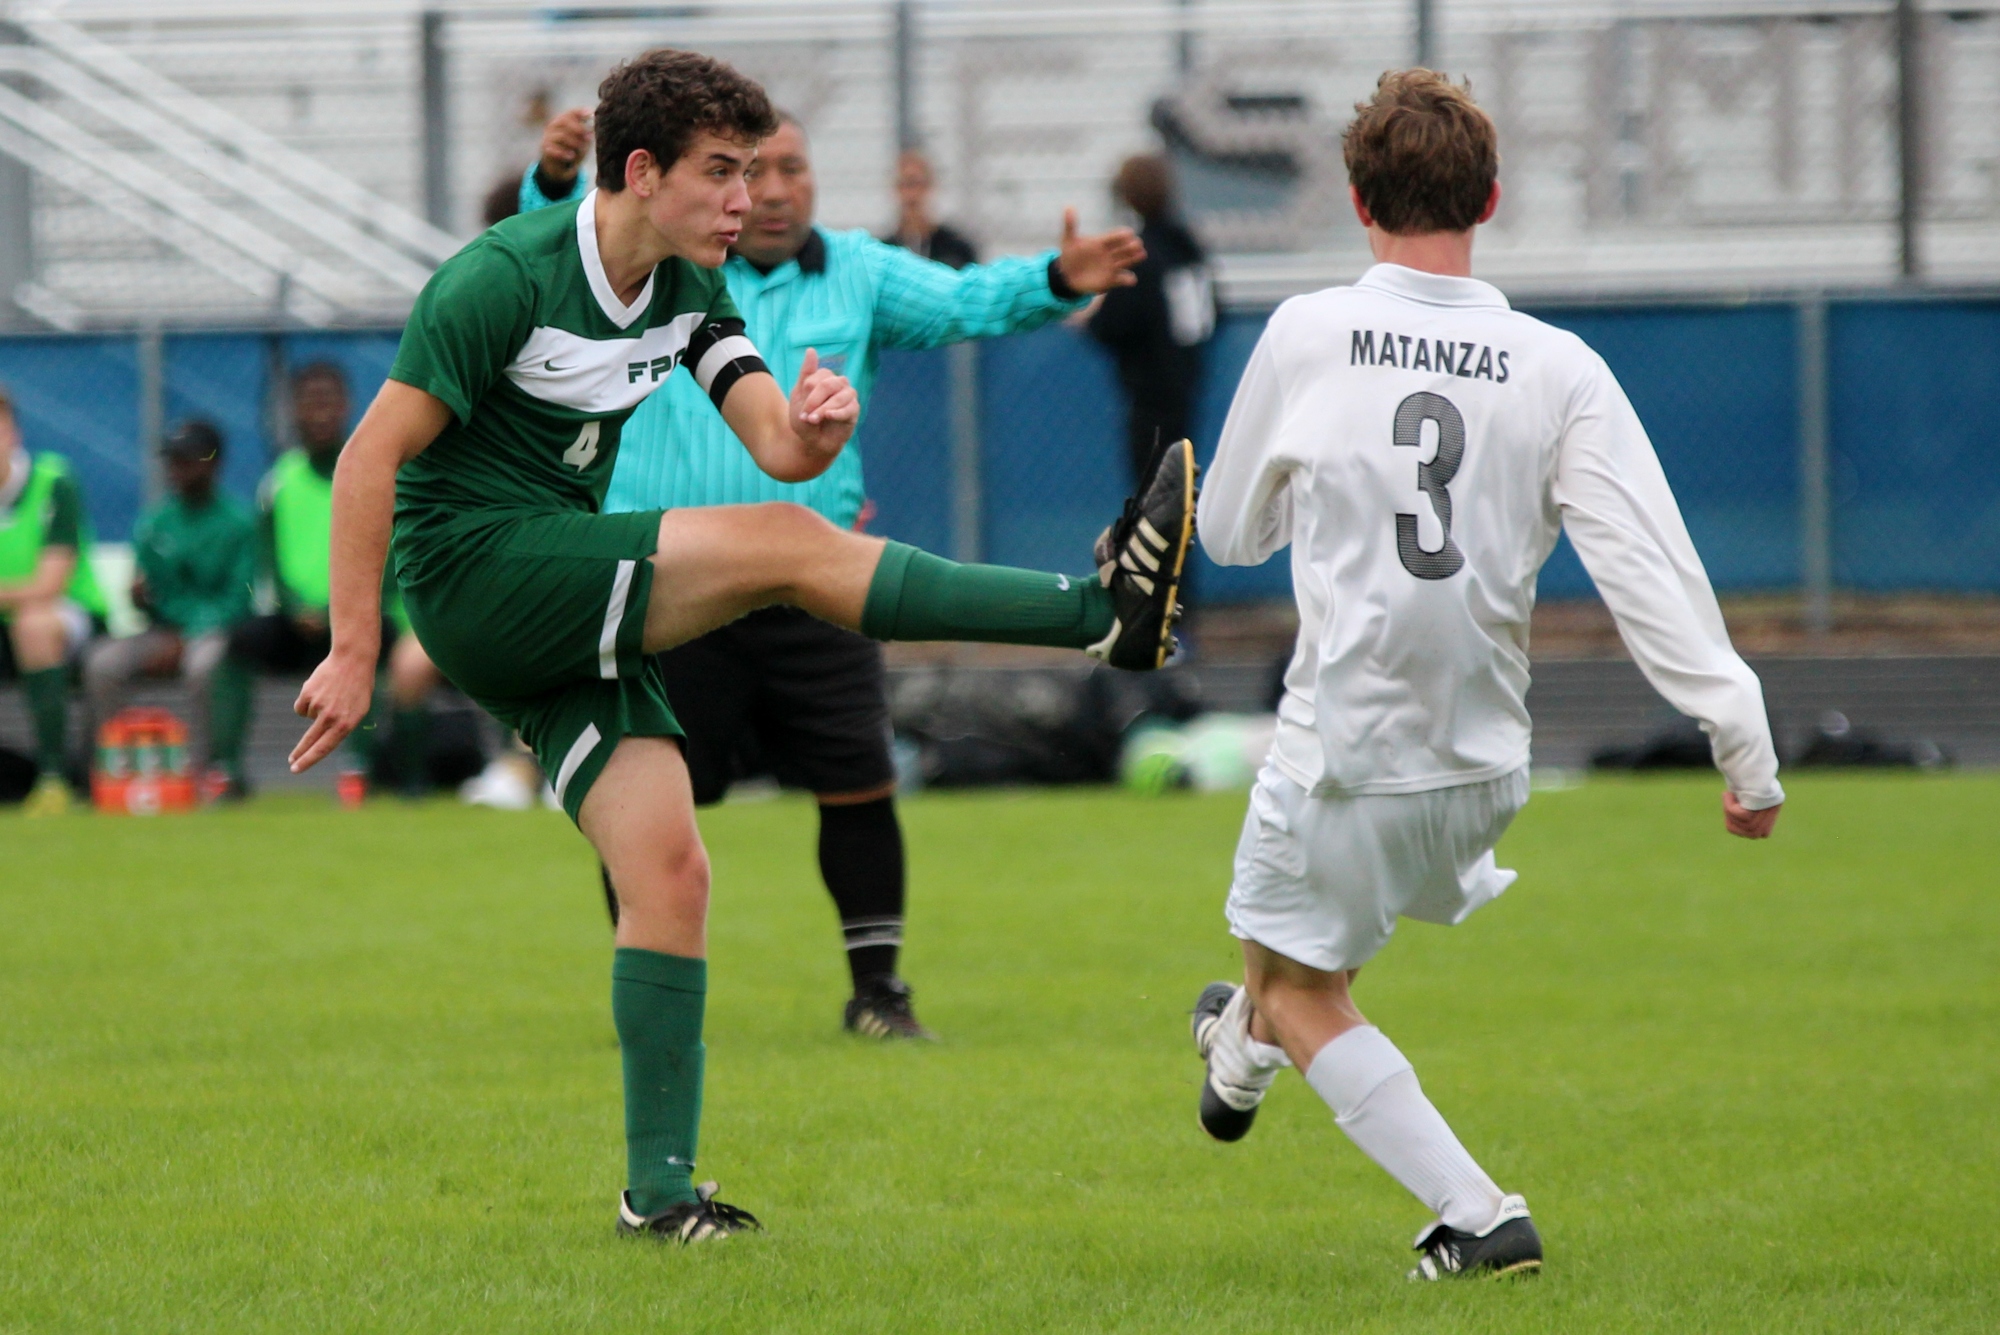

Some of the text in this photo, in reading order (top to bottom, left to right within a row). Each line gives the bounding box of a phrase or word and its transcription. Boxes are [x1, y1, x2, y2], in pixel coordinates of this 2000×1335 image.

[1350, 330, 1510, 384] MATANZAS
[562, 421, 600, 473] 4
[1393, 391, 1466, 580] 3
